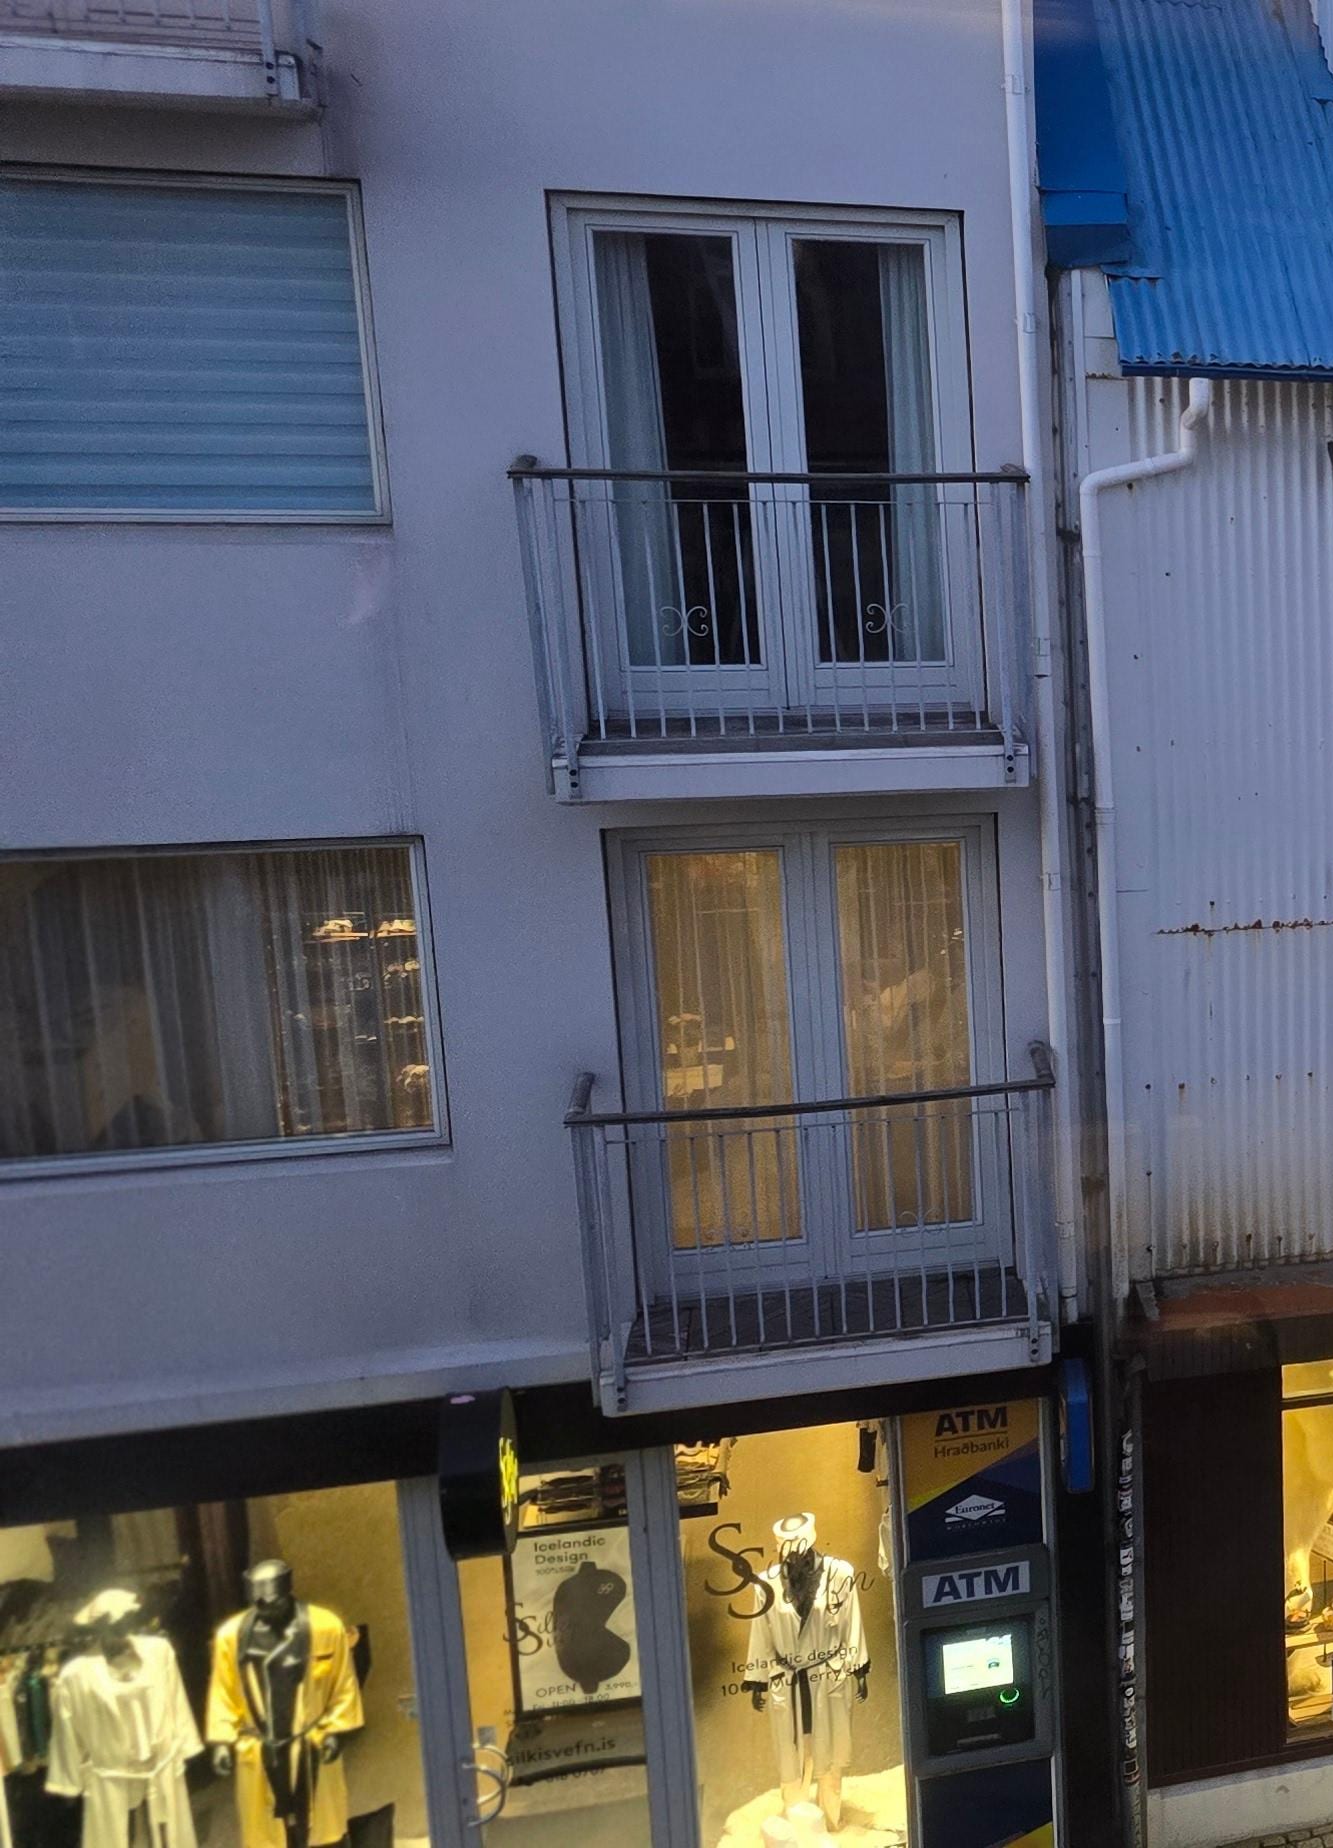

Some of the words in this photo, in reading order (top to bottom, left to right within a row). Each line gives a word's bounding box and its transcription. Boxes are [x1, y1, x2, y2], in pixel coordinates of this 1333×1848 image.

[935, 1406, 1009, 1437] ATM
[934, 1436, 1010, 1459] Hraðbanki
[954, 1502, 996, 1515] Euronet
[533, 1535, 606, 1553] Icelandic
[534, 1551, 589, 1565] Design
[932, 1565, 1020, 1604] ATM
[732, 1653, 803, 1674] Icelandic
[807, 1645, 858, 1666] design
[769, 1668, 842, 1690] Muerry
[535, 1683, 577, 1698] OPEN
[506, 1736, 617, 1767] silkisvefn.is
